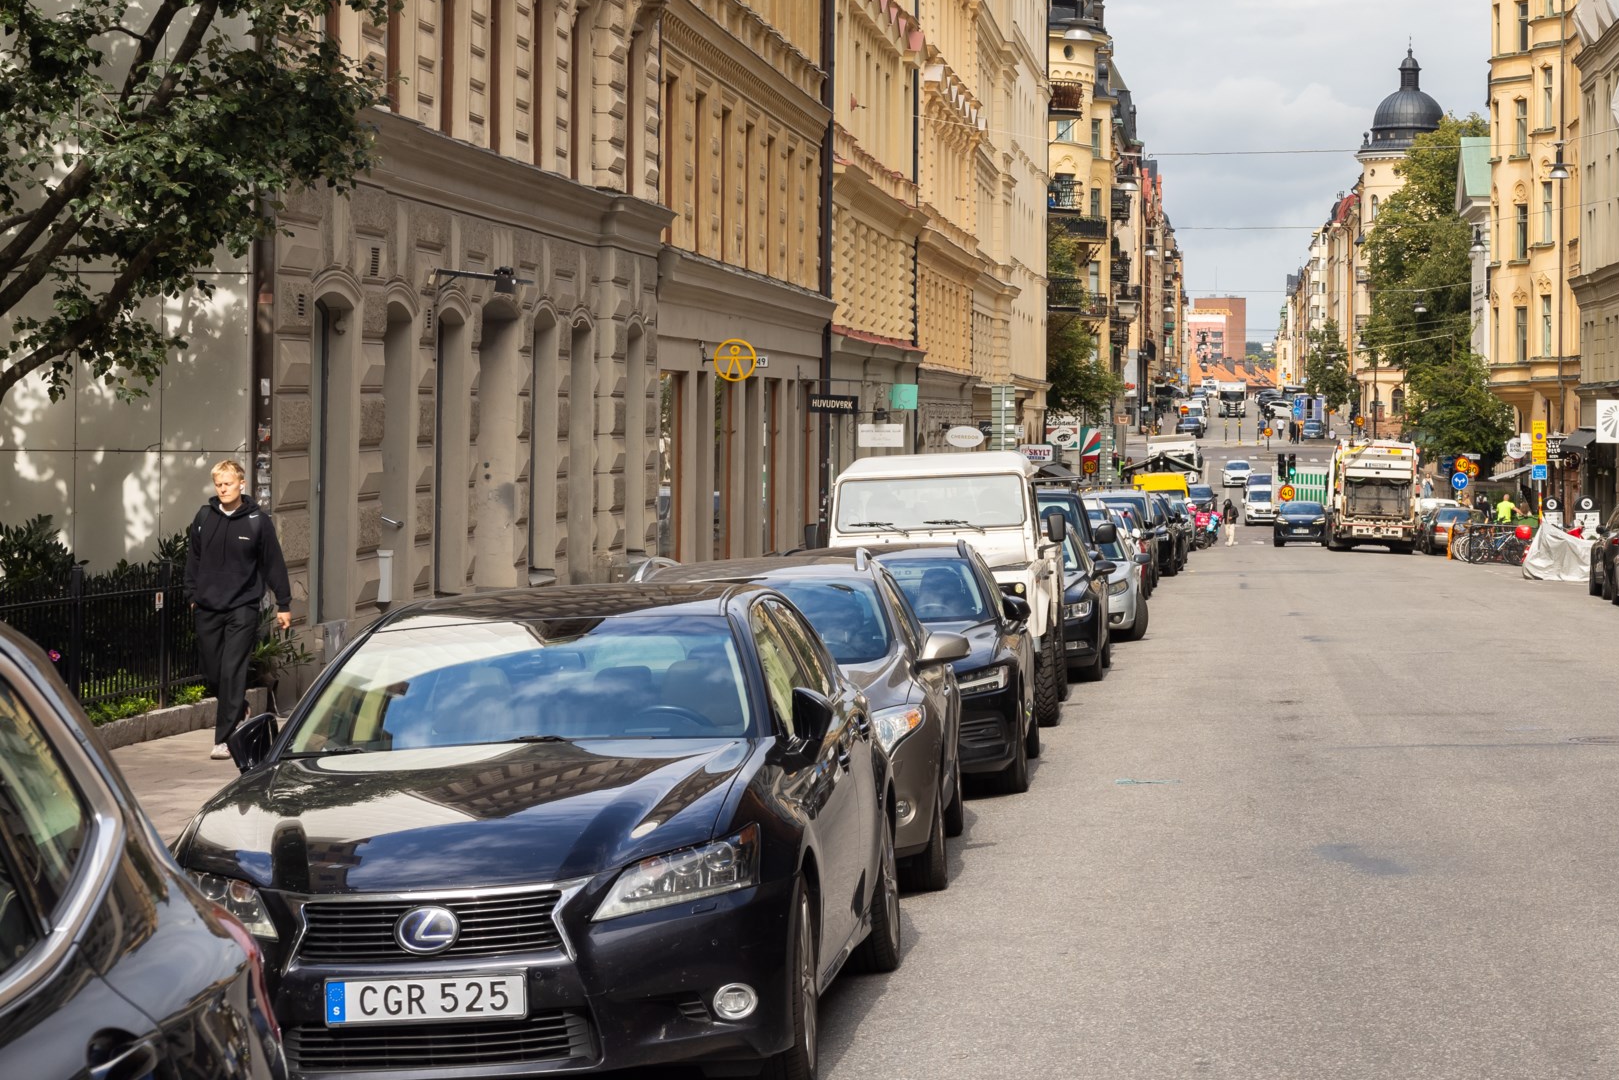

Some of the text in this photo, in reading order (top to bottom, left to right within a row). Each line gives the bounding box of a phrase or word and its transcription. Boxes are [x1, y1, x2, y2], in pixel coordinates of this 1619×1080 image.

[756, 357, 766, 366] 49
[1084, 463, 1094, 471] 30
[1457, 461, 1467, 469] 40
[359, 980, 509, 1016] CGR 525
